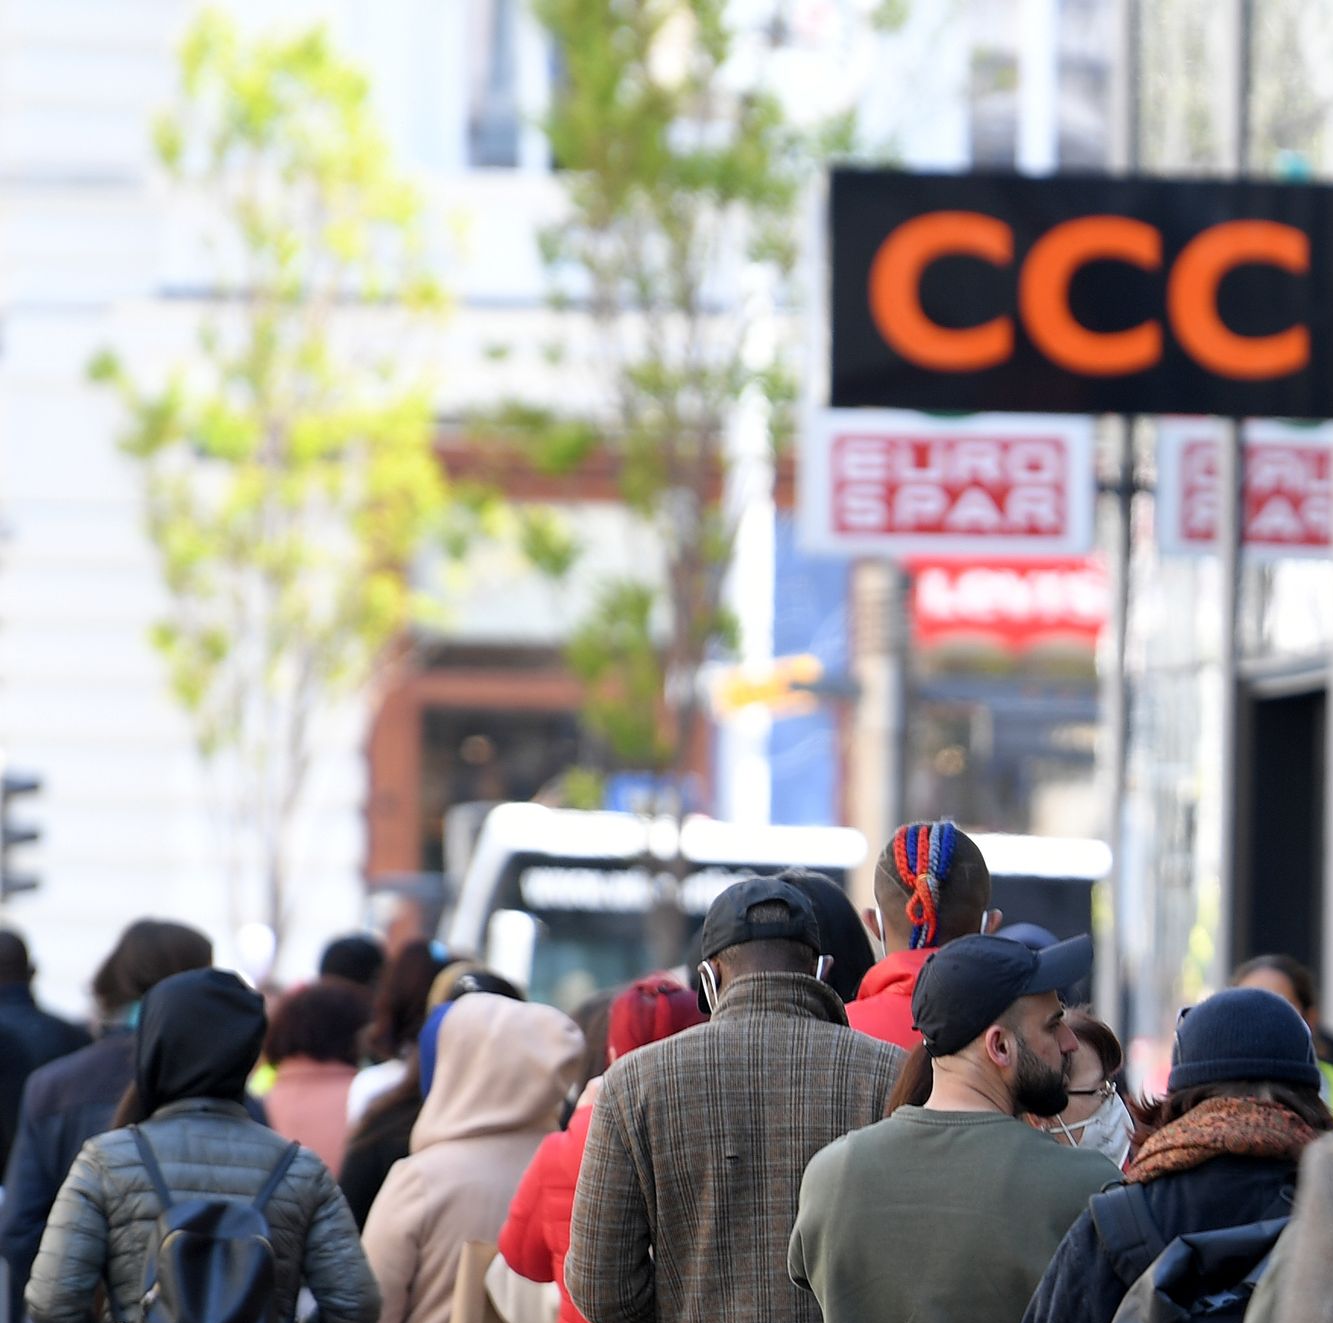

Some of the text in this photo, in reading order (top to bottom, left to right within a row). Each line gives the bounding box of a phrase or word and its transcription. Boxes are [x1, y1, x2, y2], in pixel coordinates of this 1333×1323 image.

[870, 210, 1311, 380] CCC
[836, 437, 1064, 482] EURO
[836, 484, 1064, 532] SPAR
